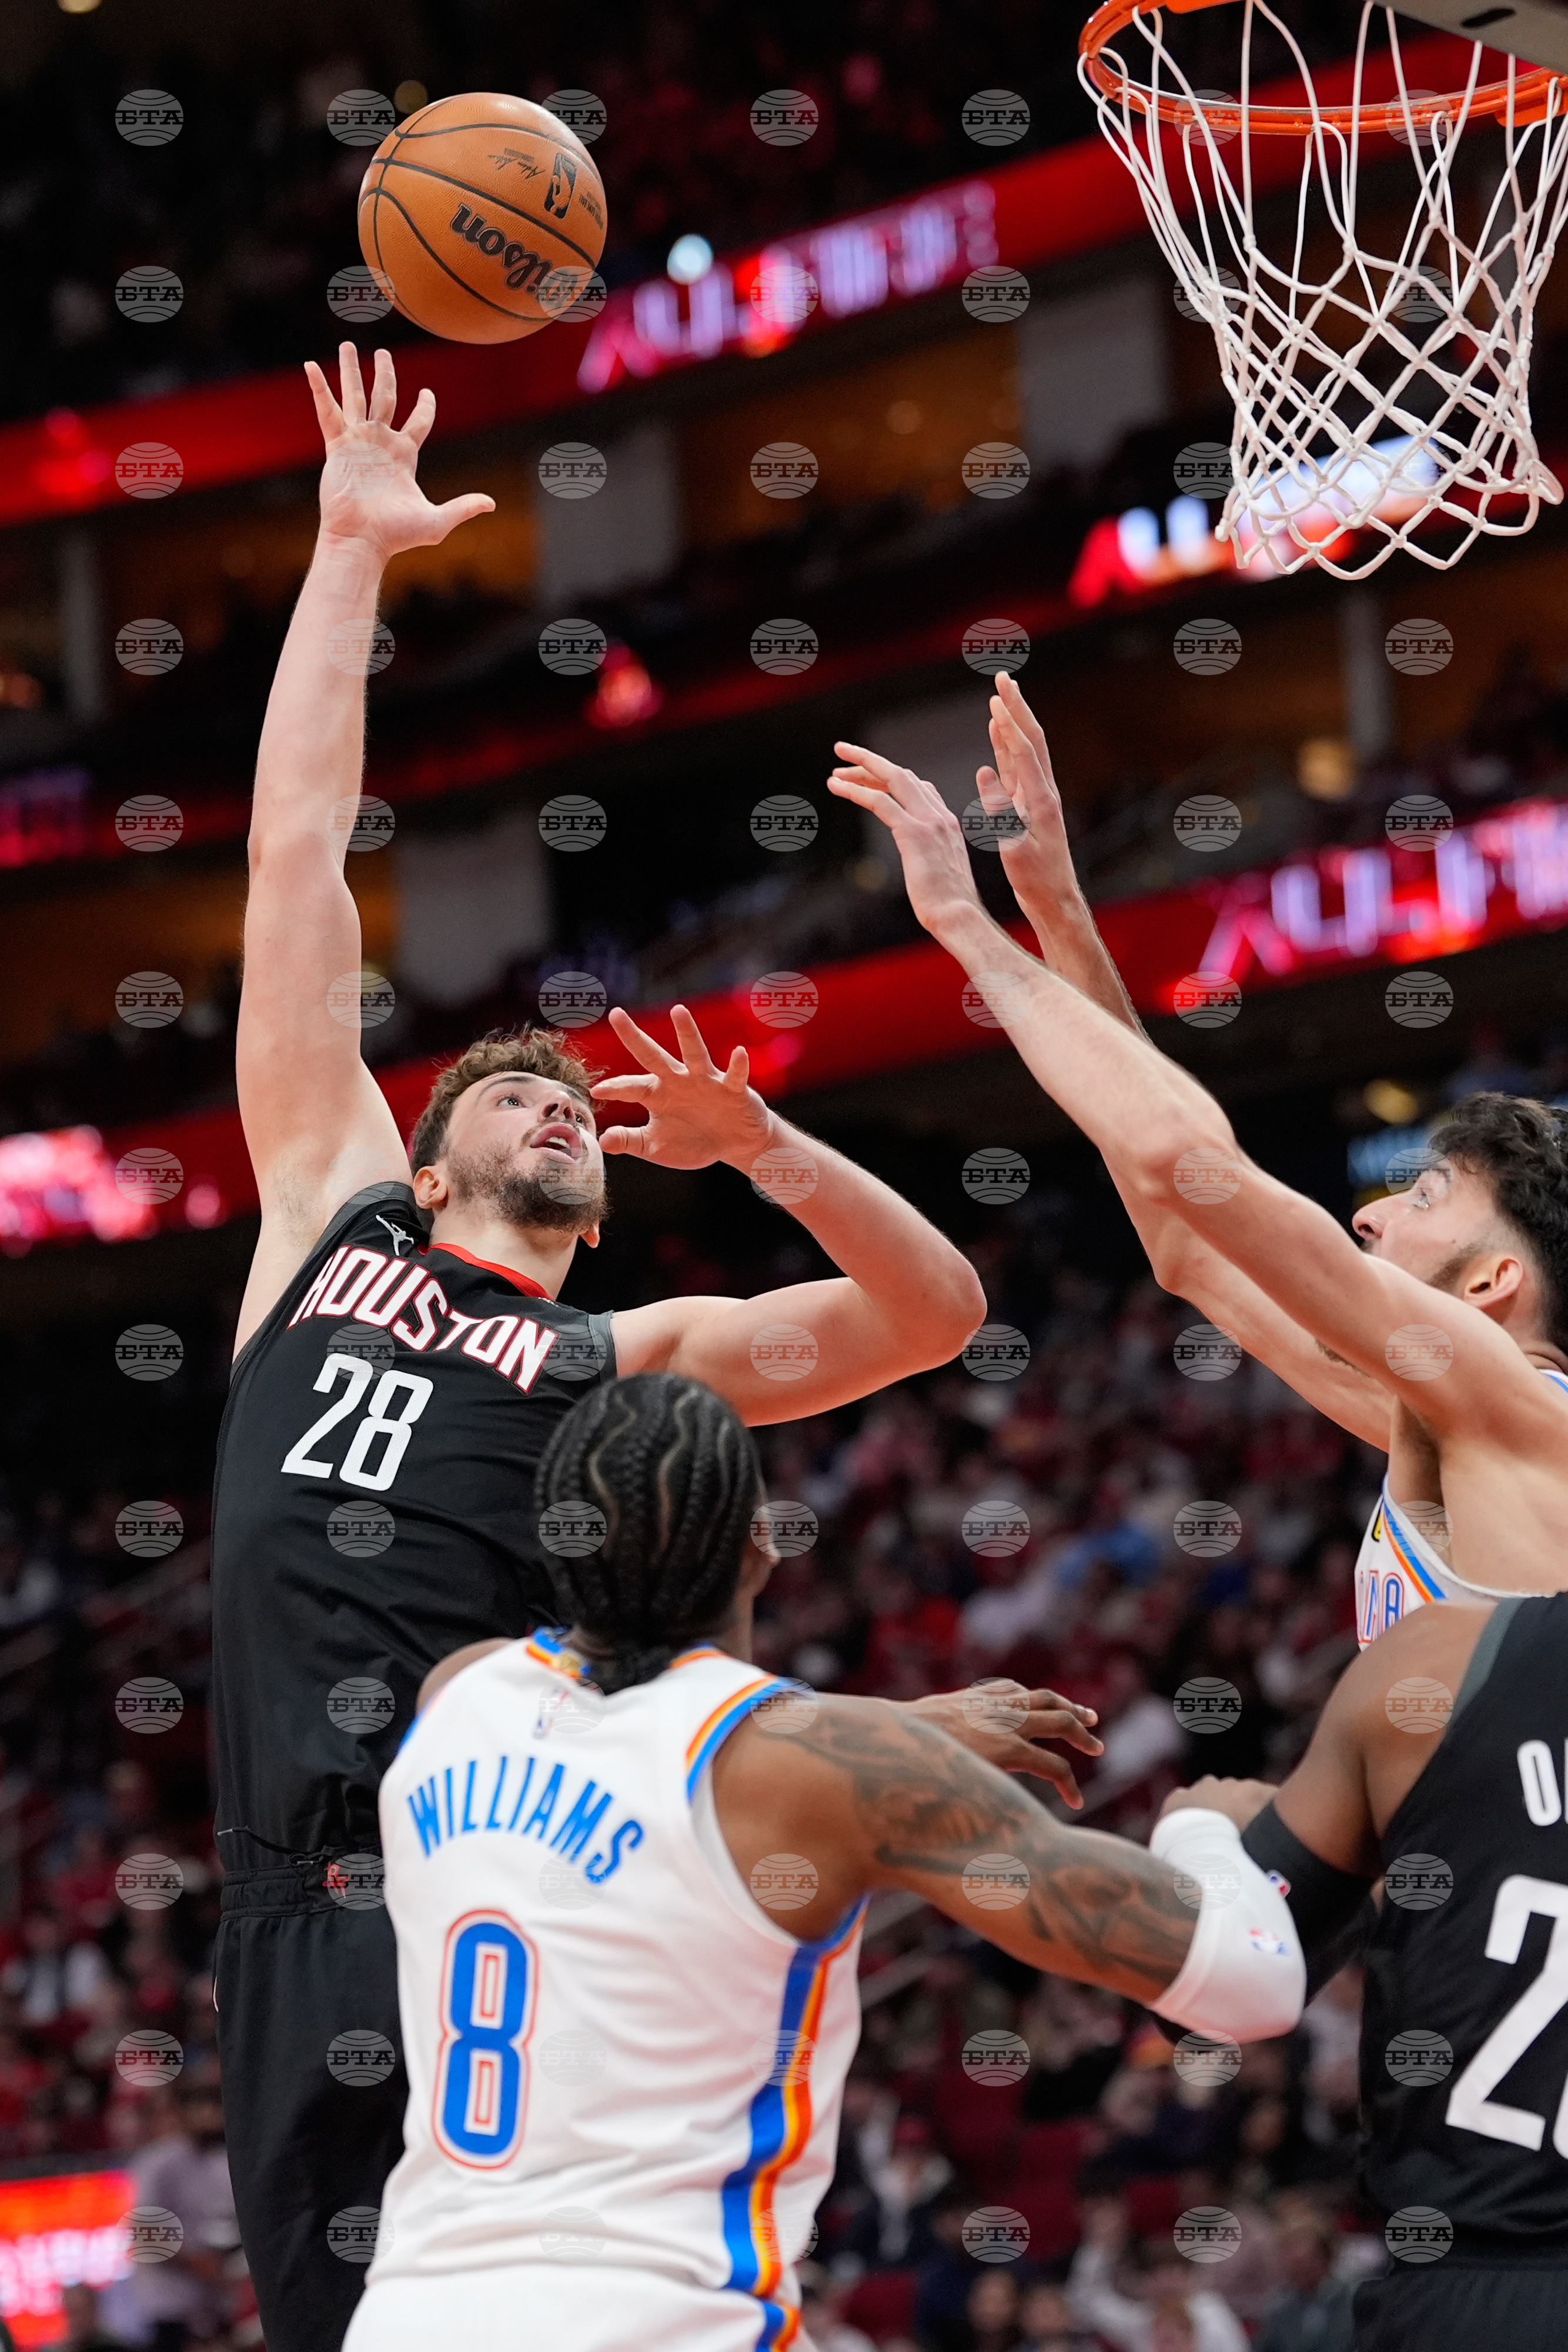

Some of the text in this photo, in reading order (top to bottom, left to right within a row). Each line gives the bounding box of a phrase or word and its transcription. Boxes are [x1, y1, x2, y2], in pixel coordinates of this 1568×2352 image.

[450, 203, 578, 309] Wilson
[287, 1245, 557, 1395] HOUSTON
[281, 1353, 434, 1492] 28
[408, 1755, 645, 1885] WILLIAMS
[1517, 1739, 1568, 1826] O
[432, 1909, 540, 2170] 8
[1445, 1874, 1568, 2159] 2
